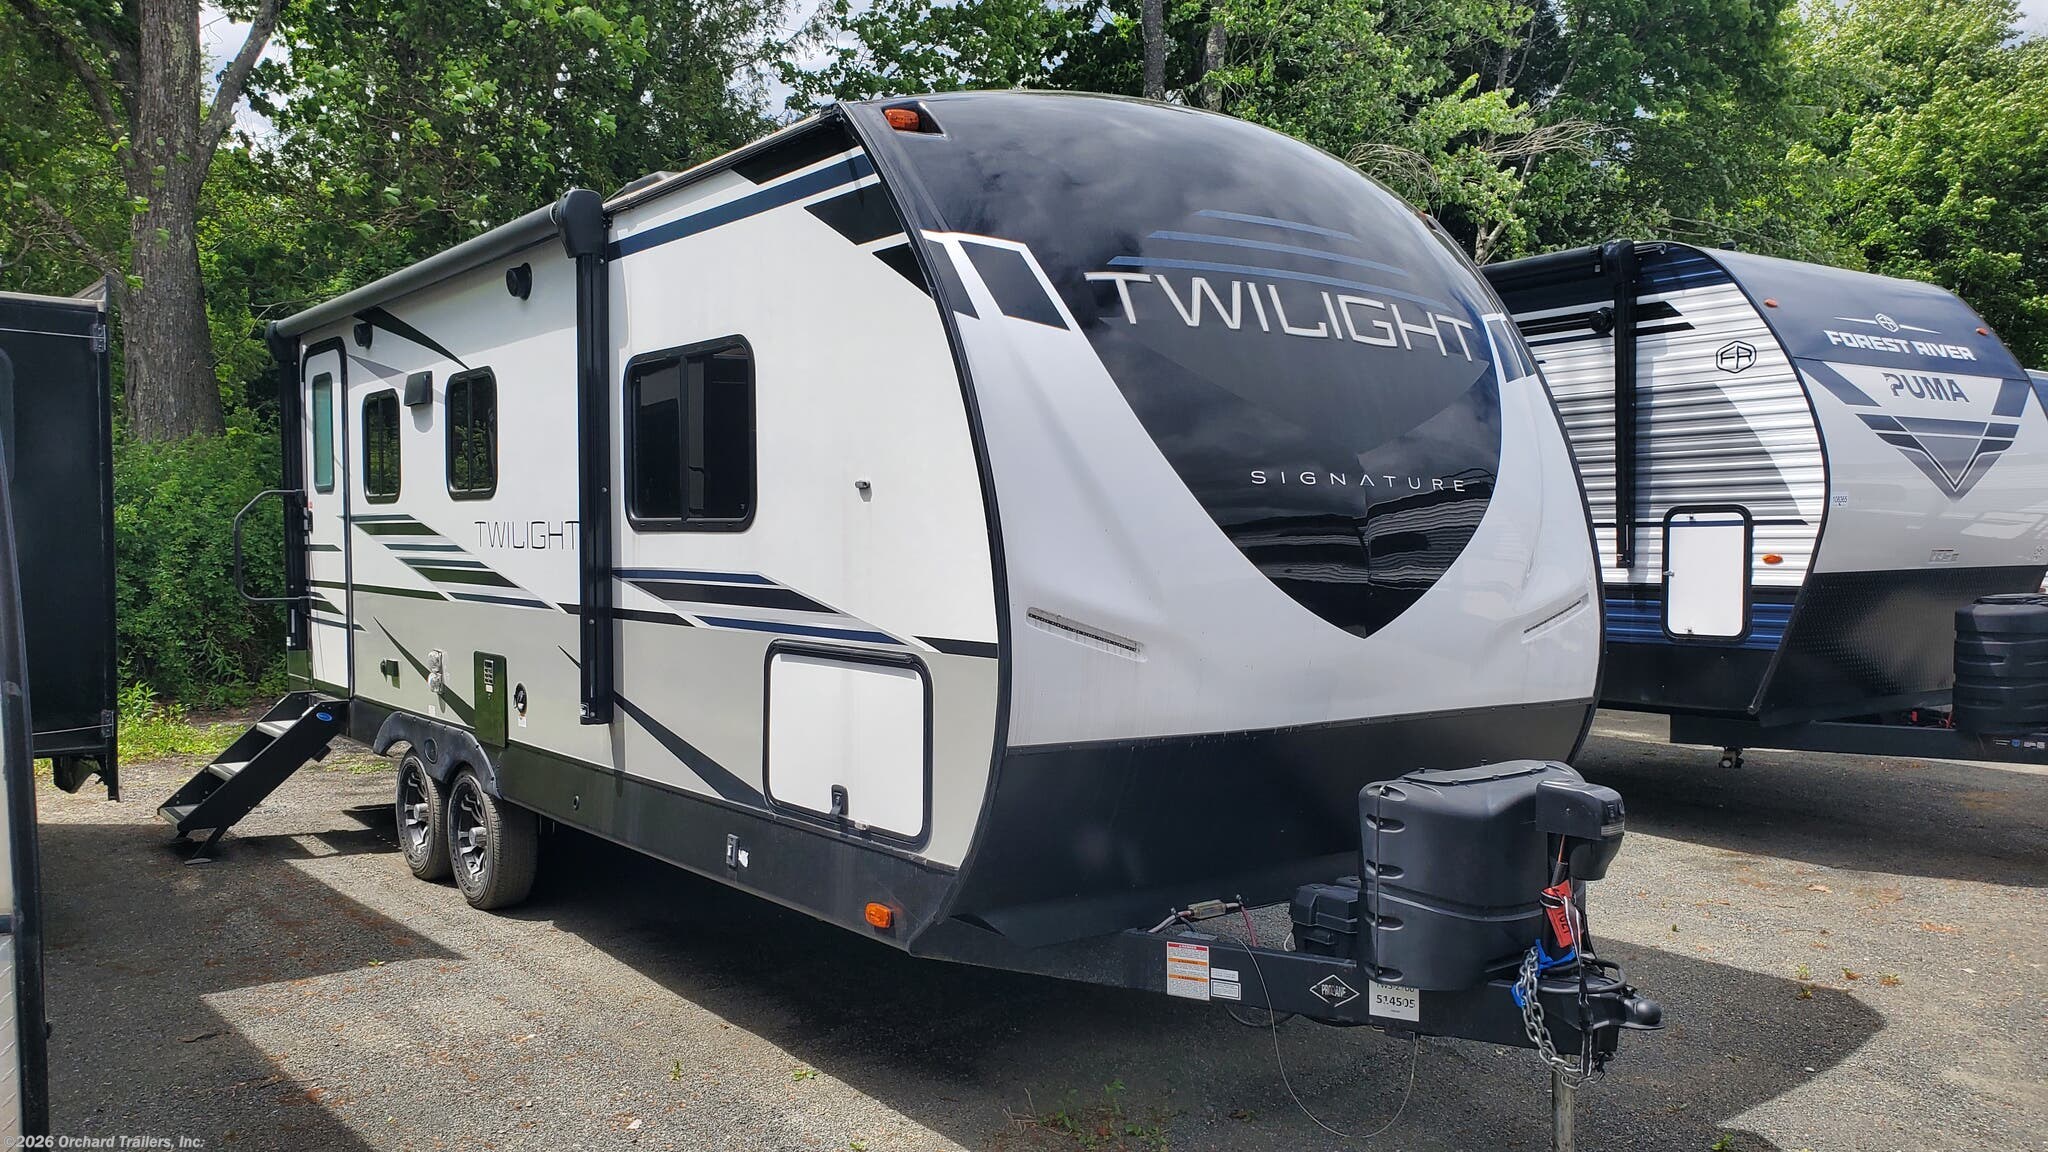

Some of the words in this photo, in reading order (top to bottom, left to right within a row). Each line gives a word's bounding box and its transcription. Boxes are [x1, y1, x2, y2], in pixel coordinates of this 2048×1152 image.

[1083, 271, 1473, 362] TWILIGHT
[1823, 330, 1911, 354] FOREST
[1911, 341, 1977, 361] RIVER
[1881, 372, 1970, 403] PUMA
[1250, 469, 1466, 493] SIGNATURE
[474, 521, 580, 550] TWILIGHT
